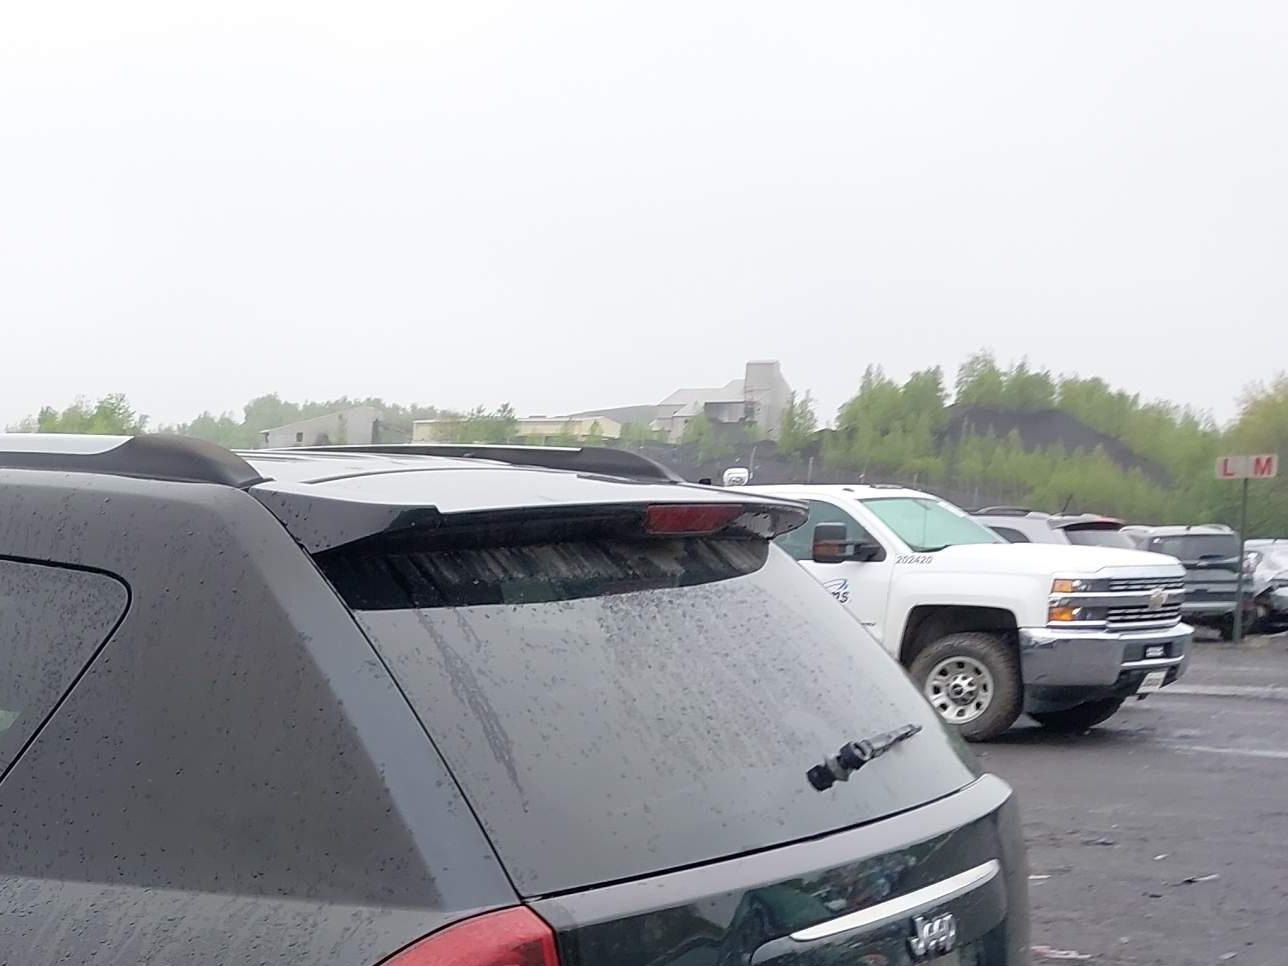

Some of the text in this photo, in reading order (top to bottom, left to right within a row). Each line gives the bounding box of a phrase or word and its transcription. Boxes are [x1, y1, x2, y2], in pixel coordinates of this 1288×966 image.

[1223, 456, 1273, 476] L M
[909, 912, 957, 956] Jeep
